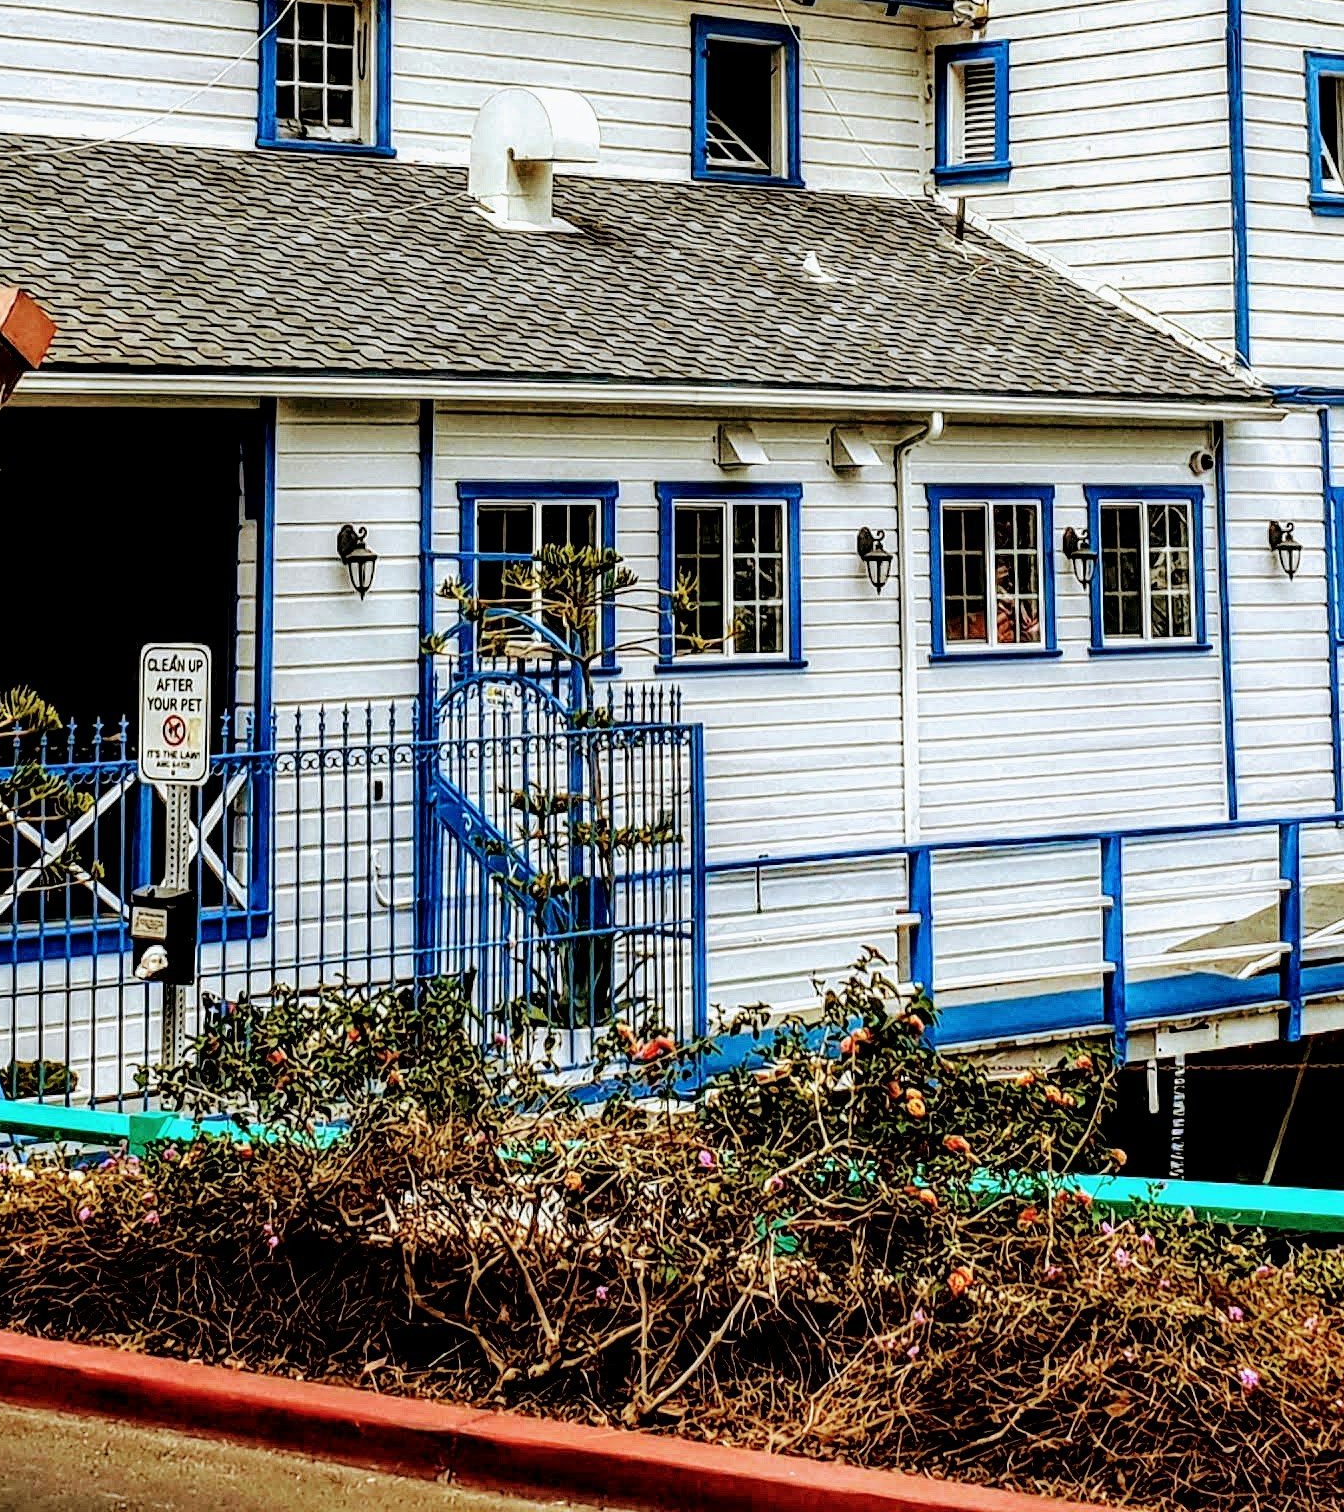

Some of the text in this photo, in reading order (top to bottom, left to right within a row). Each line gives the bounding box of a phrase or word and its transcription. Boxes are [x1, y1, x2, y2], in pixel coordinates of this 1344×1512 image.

[147, 656, 204, 673] CLEAN UP
[156, 678, 193, 692] AFTER
[147, 697, 203, 712] YOUR PET
[163, 750, 178, 759] THE
